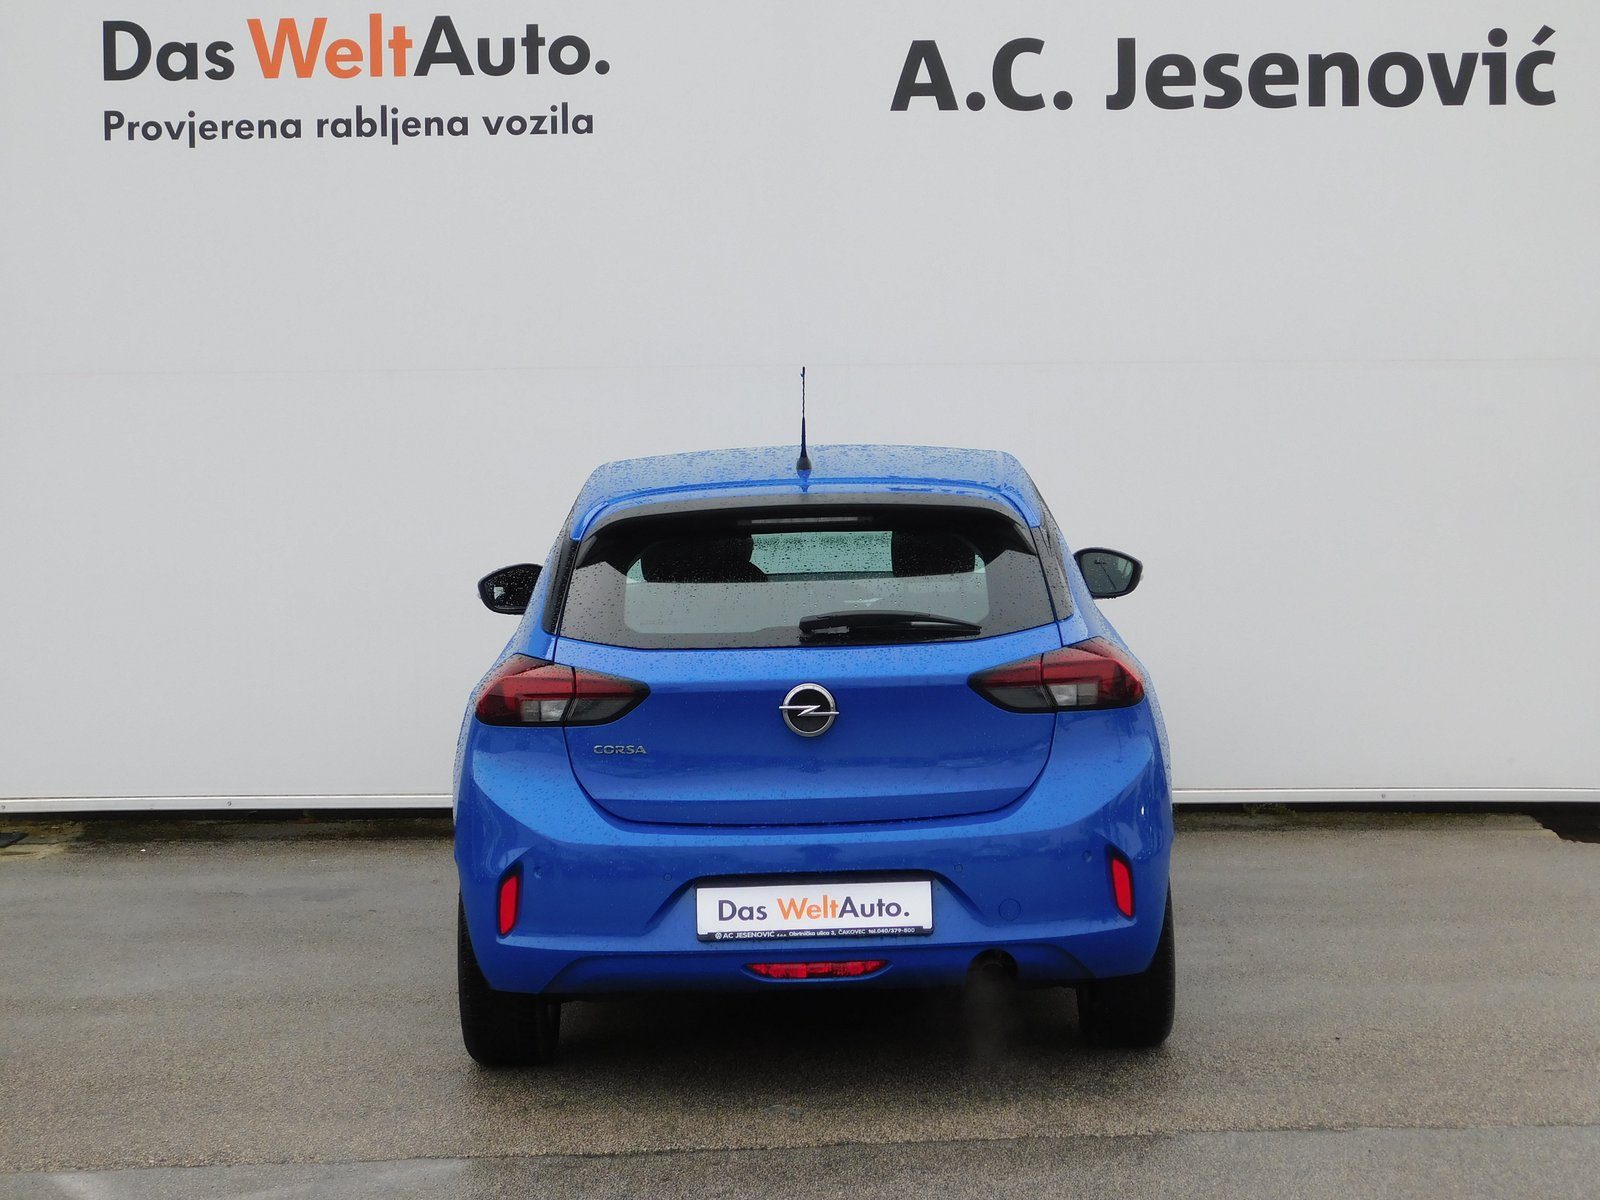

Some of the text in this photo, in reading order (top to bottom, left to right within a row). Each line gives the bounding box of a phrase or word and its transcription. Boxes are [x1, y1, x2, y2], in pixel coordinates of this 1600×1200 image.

[103, 13, 610, 82] Das WeltAuto.
[889, 24, 1557, 112] A.C. Jesenović
[103, 102, 594, 149] Provjerena rabljena vozila
[593, 744, 647, 755] CORSA
[718, 894, 910, 921] Das WeltAuto.
